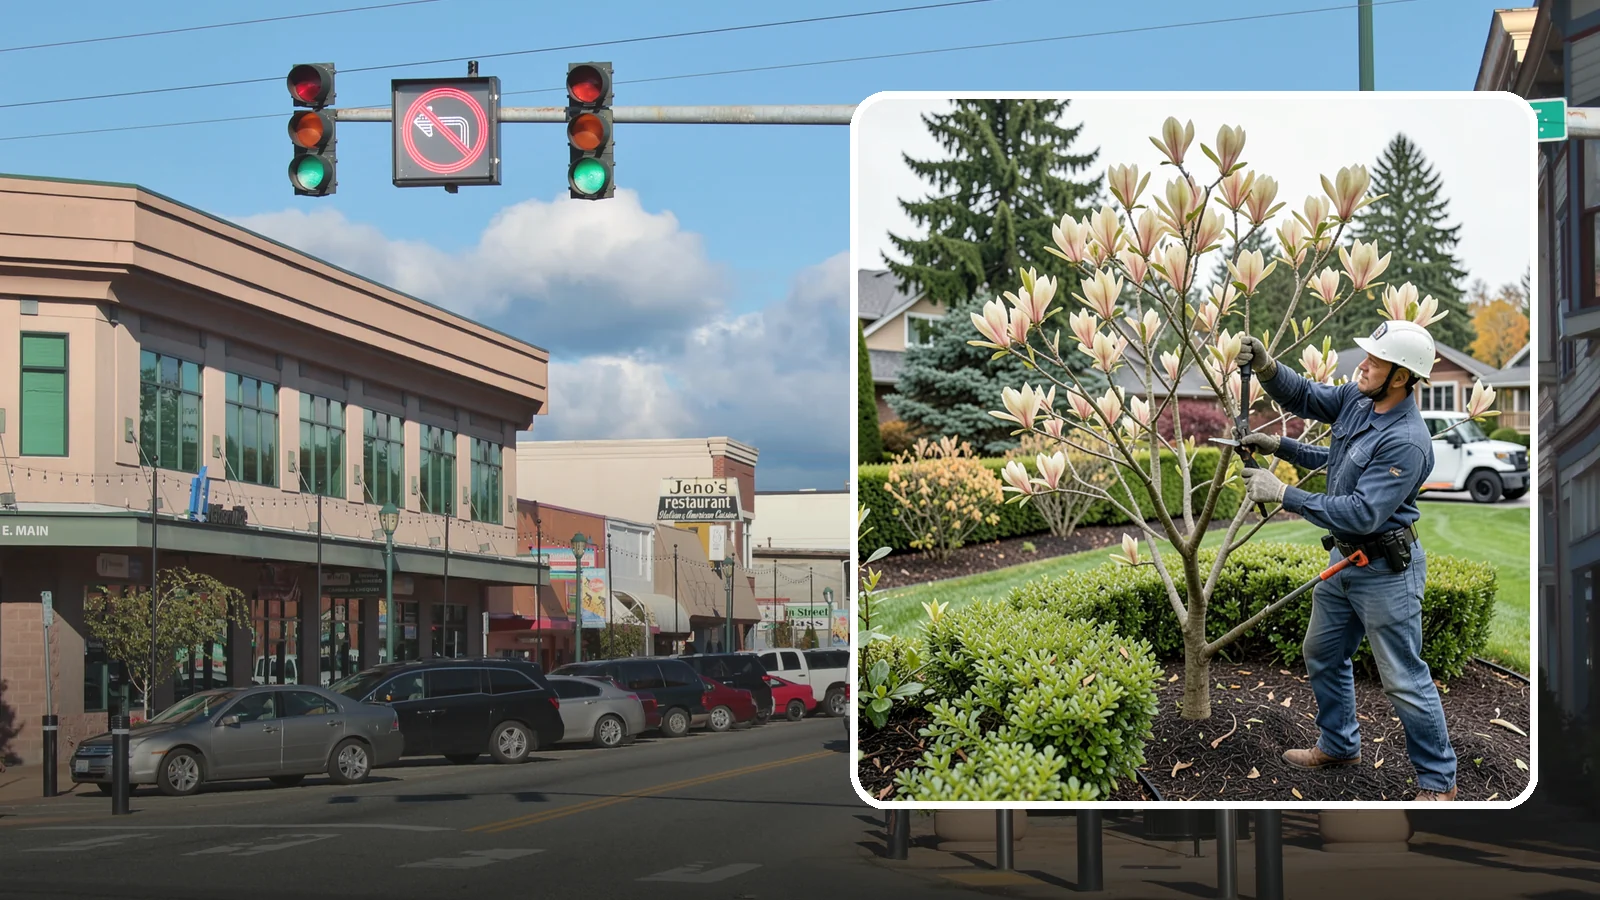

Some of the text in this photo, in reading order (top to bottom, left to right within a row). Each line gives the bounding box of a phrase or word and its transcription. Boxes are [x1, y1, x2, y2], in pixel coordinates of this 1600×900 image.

[670, 480, 727, 494] Jeno's
[665, 496, 731, 509] restaurant
[659, 510, 682, 519] Italian
[686, 510, 714, 519] American
[715, 509, 737, 519] Cuisine
[2, 525, 49, 536] E. MAIN
[797, 607, 828, 616] Street
[791, 619, 823, 627] lass
